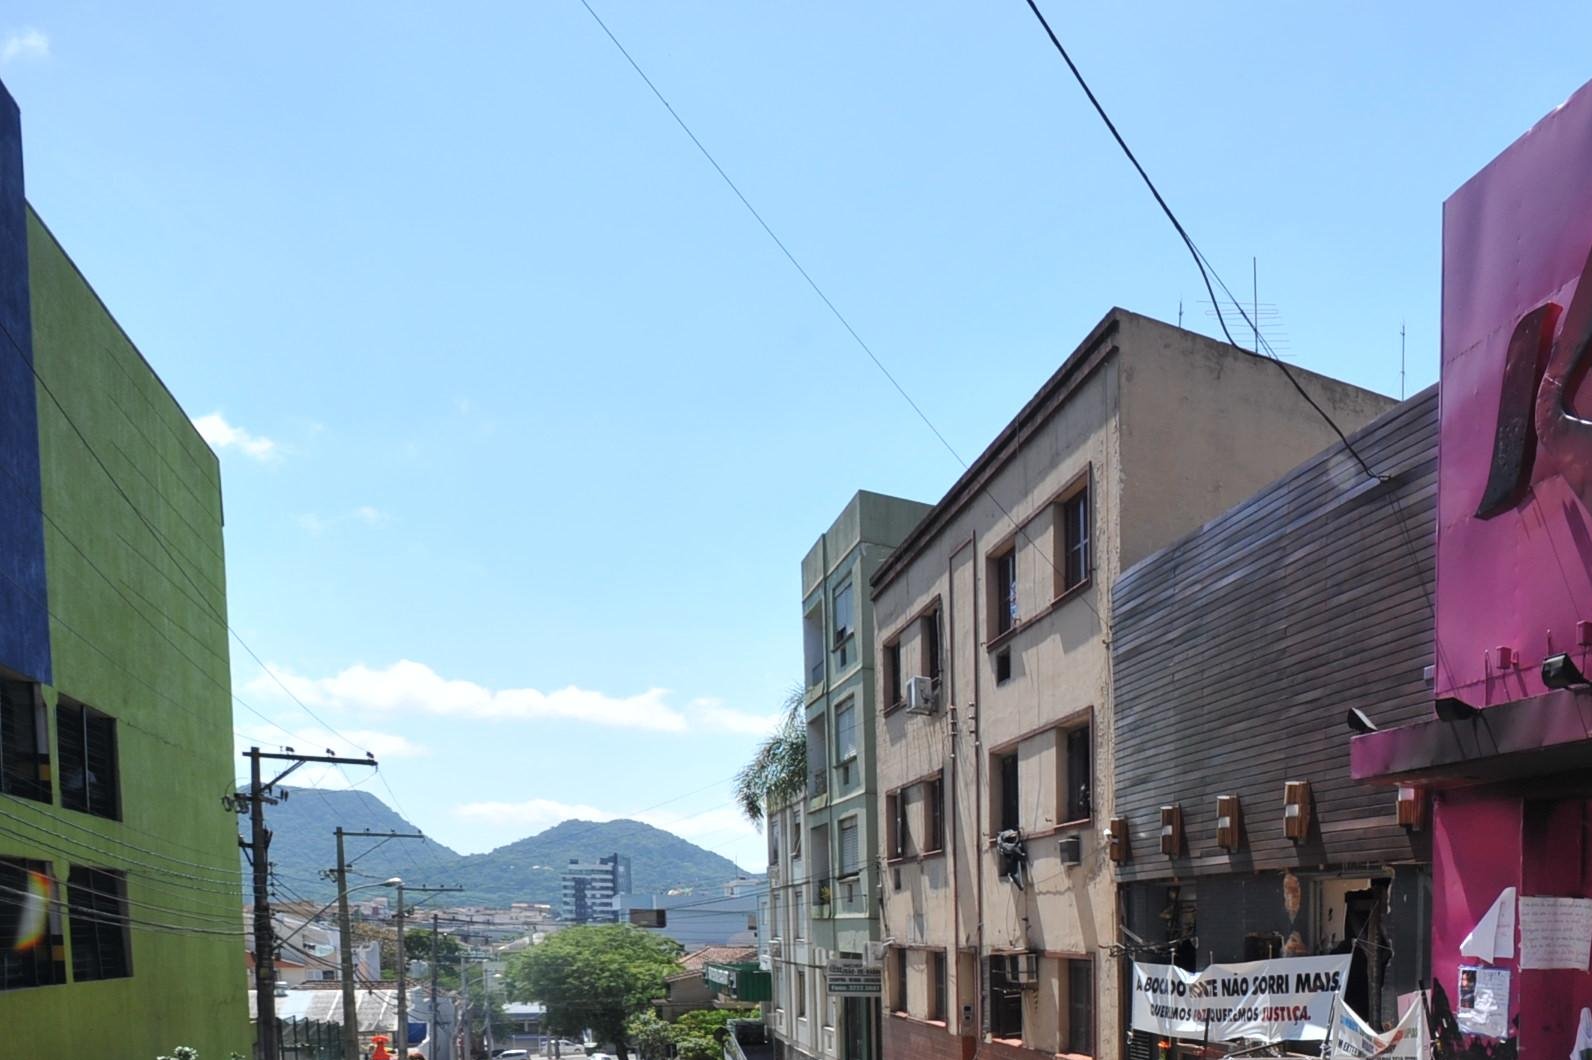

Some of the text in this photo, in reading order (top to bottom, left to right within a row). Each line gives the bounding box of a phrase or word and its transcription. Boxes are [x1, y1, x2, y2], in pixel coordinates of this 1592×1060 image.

[1135, 976, 1143, 992] A
[1168, 978, 1187, 998] DO
[1221, 973, 1249, 998] NÃO
[1252, 973, 1290, 995] SORRI
[1295, 970, 1342, 994] MAIS.
[1260, 1004, 1312, 1026] JUSTIÇA.
